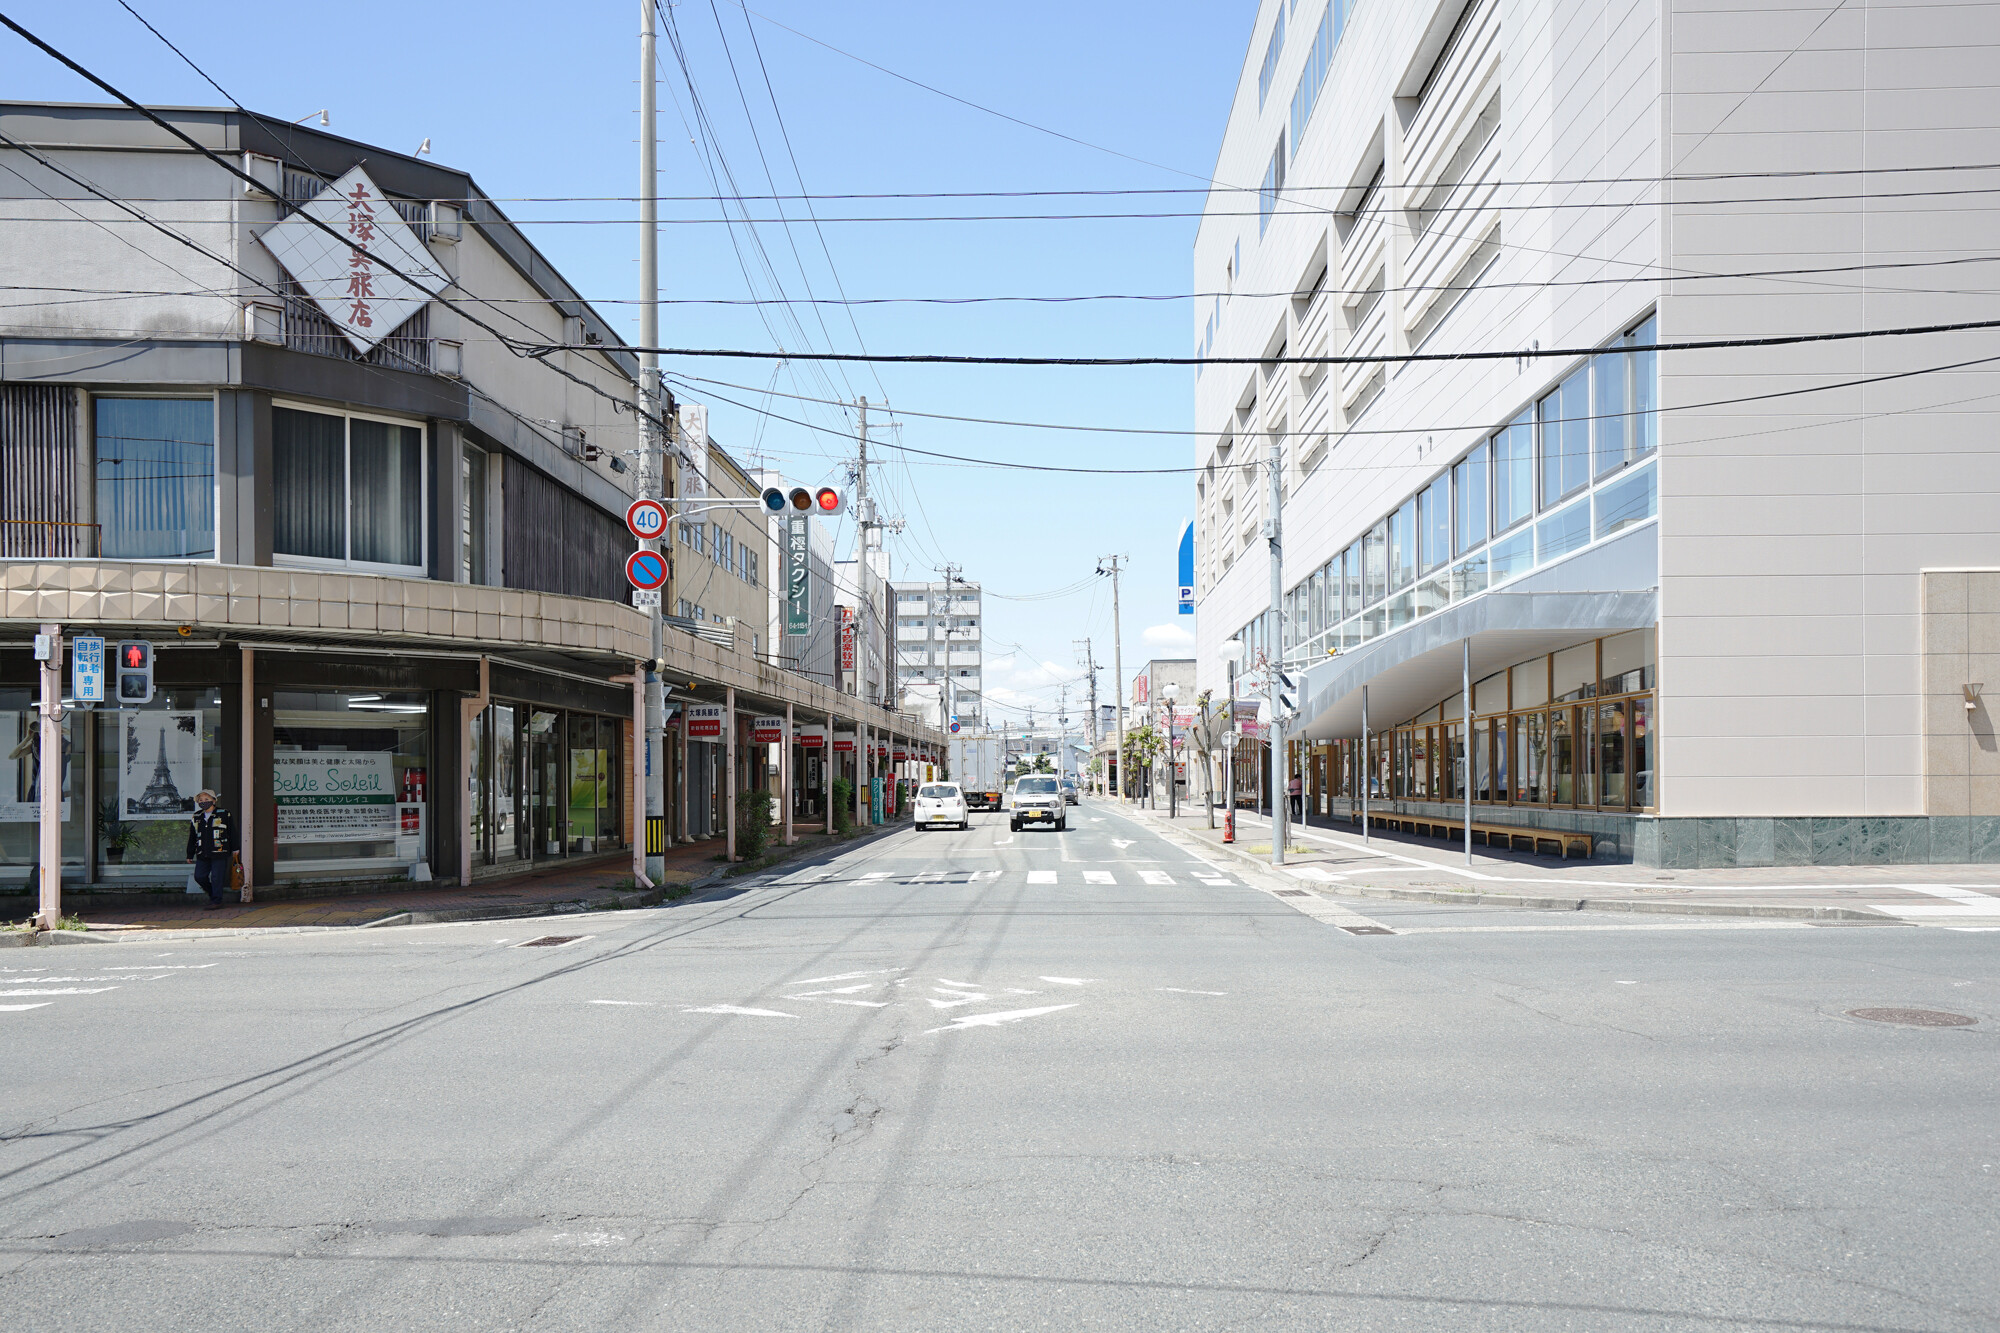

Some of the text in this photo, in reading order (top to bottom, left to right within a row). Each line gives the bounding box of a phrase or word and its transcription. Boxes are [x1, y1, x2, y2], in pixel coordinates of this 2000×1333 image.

[346, 183, 376, 328] 大塚呉服店
[636, 510, 659, 529] 40
[790, 516, 806, 616] 重樫タクシー
[1181, 588, 1191, 599] P
[82, 675, 94, 697] 専用
[689, 708, 720, 717] 大塚呉服店
[274, 768, 383, 792] Belle Soleil
[319, 796, 369, 804] ベルソレイユ
[278, 808, 351, 816] 際抗加齢免疫医学学会
